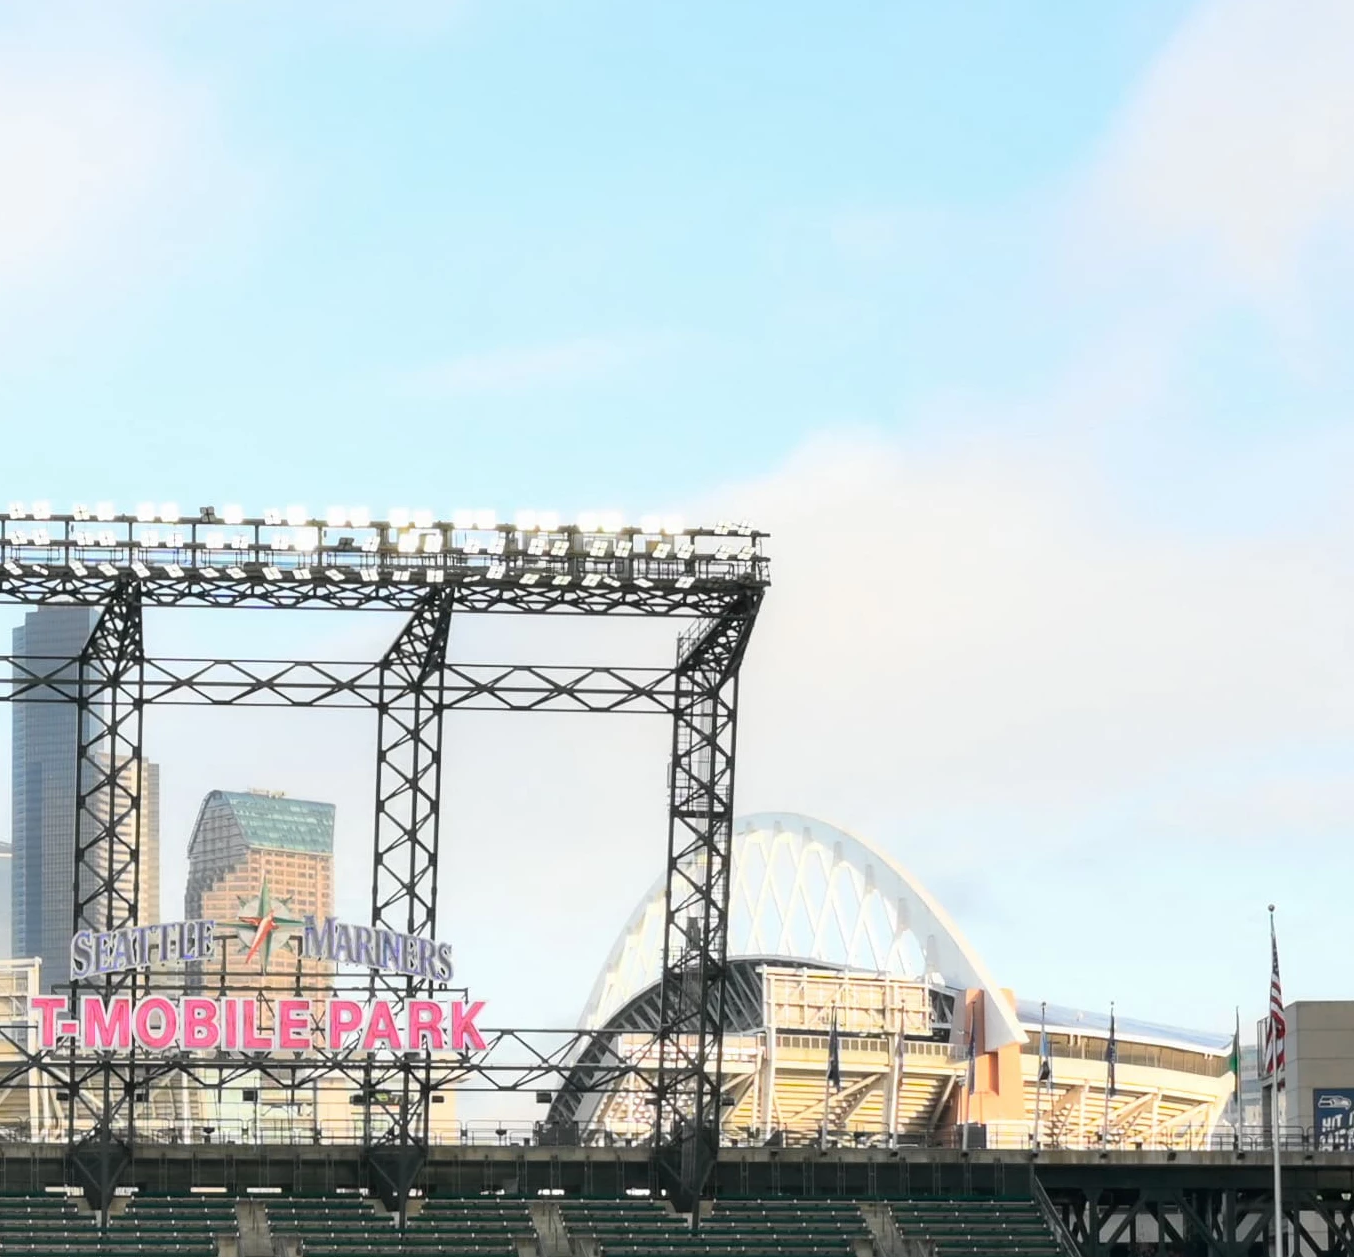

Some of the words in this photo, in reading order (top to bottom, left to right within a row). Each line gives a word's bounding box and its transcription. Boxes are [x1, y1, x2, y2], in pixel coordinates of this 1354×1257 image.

[70, 920, 215, 981] SEATTLE
[302, 915, 454, 982] MARINERS
[30, 997, 316, 1052] T-MOBILE
[327, 997, 487, 1052] PARK
